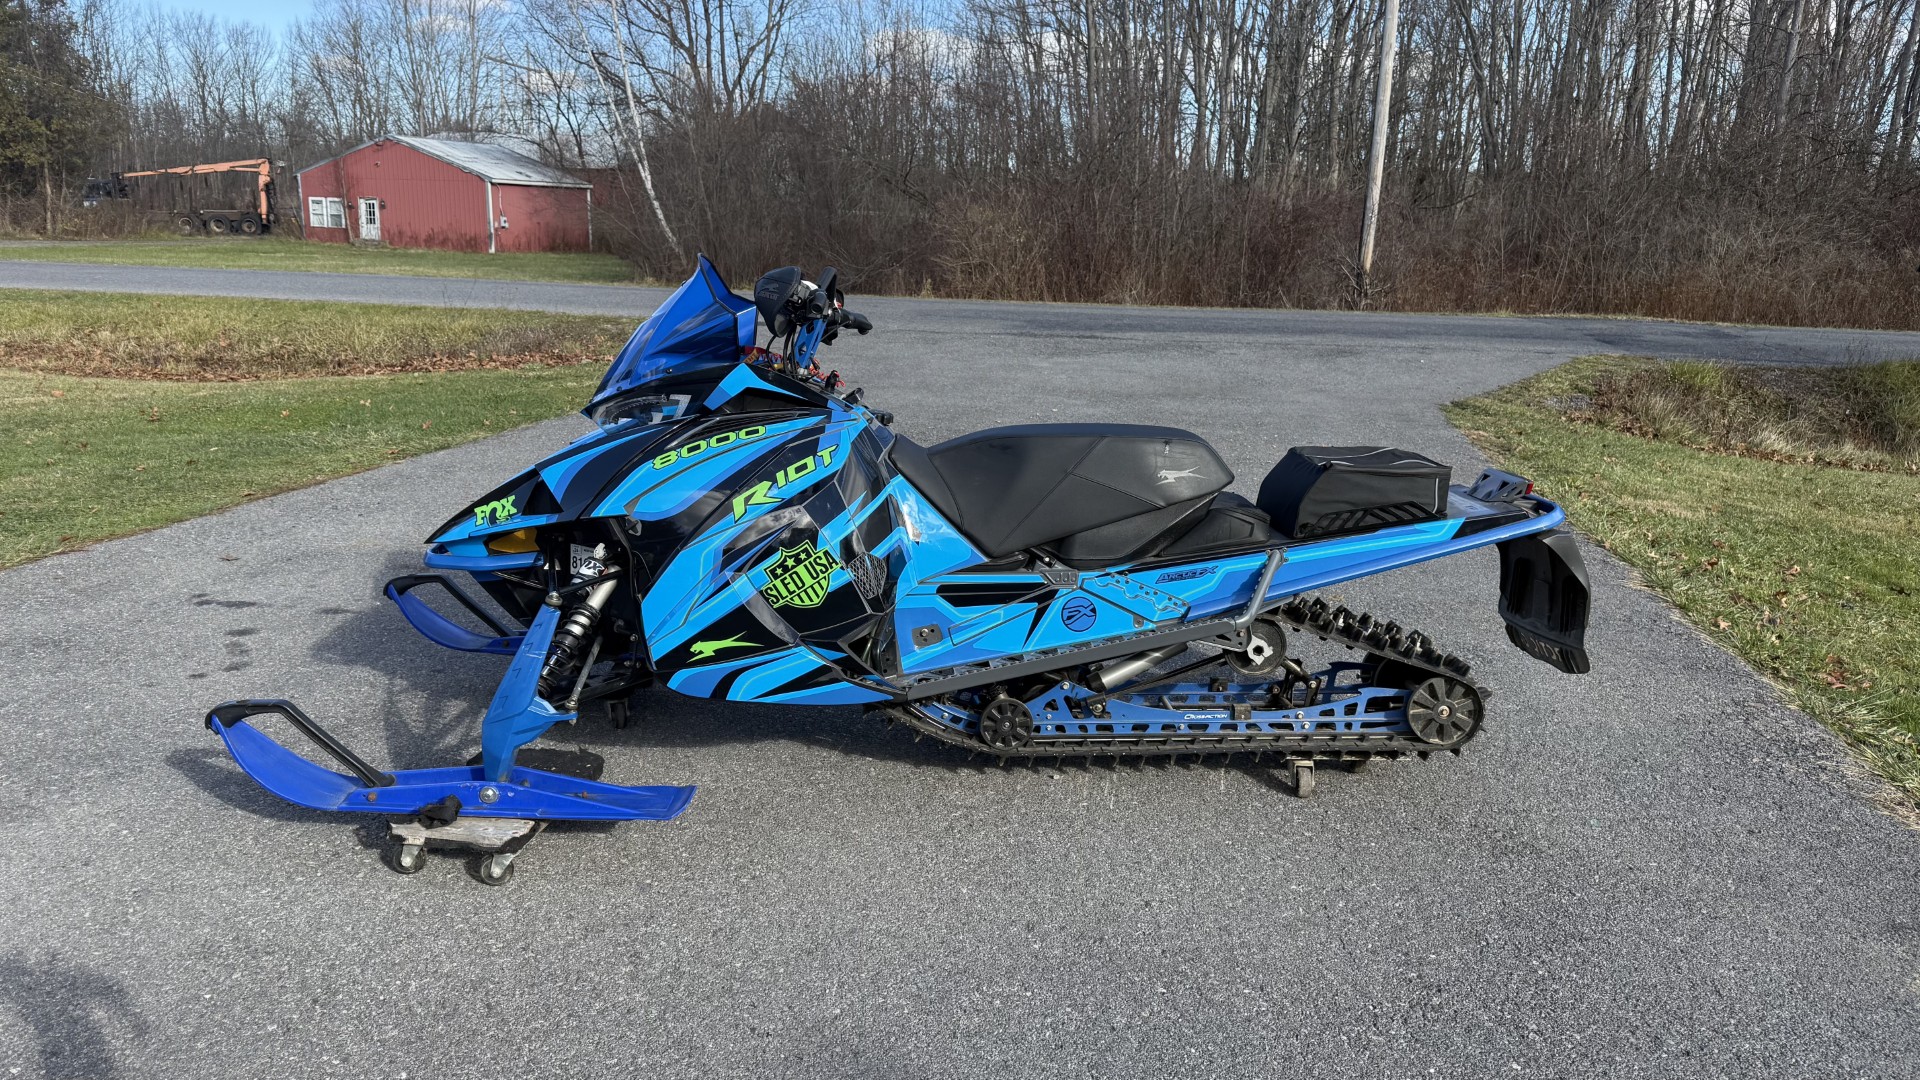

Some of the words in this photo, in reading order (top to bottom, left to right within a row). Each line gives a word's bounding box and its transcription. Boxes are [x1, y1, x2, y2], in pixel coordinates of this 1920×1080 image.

[652, 425, 767, 470] 8000
[733, 444, 839, 524] RIOT
[474, 495, 518, 527] FOX
[763, 570, 806, 605] SLED
[802, 549, 839, 581] USA
